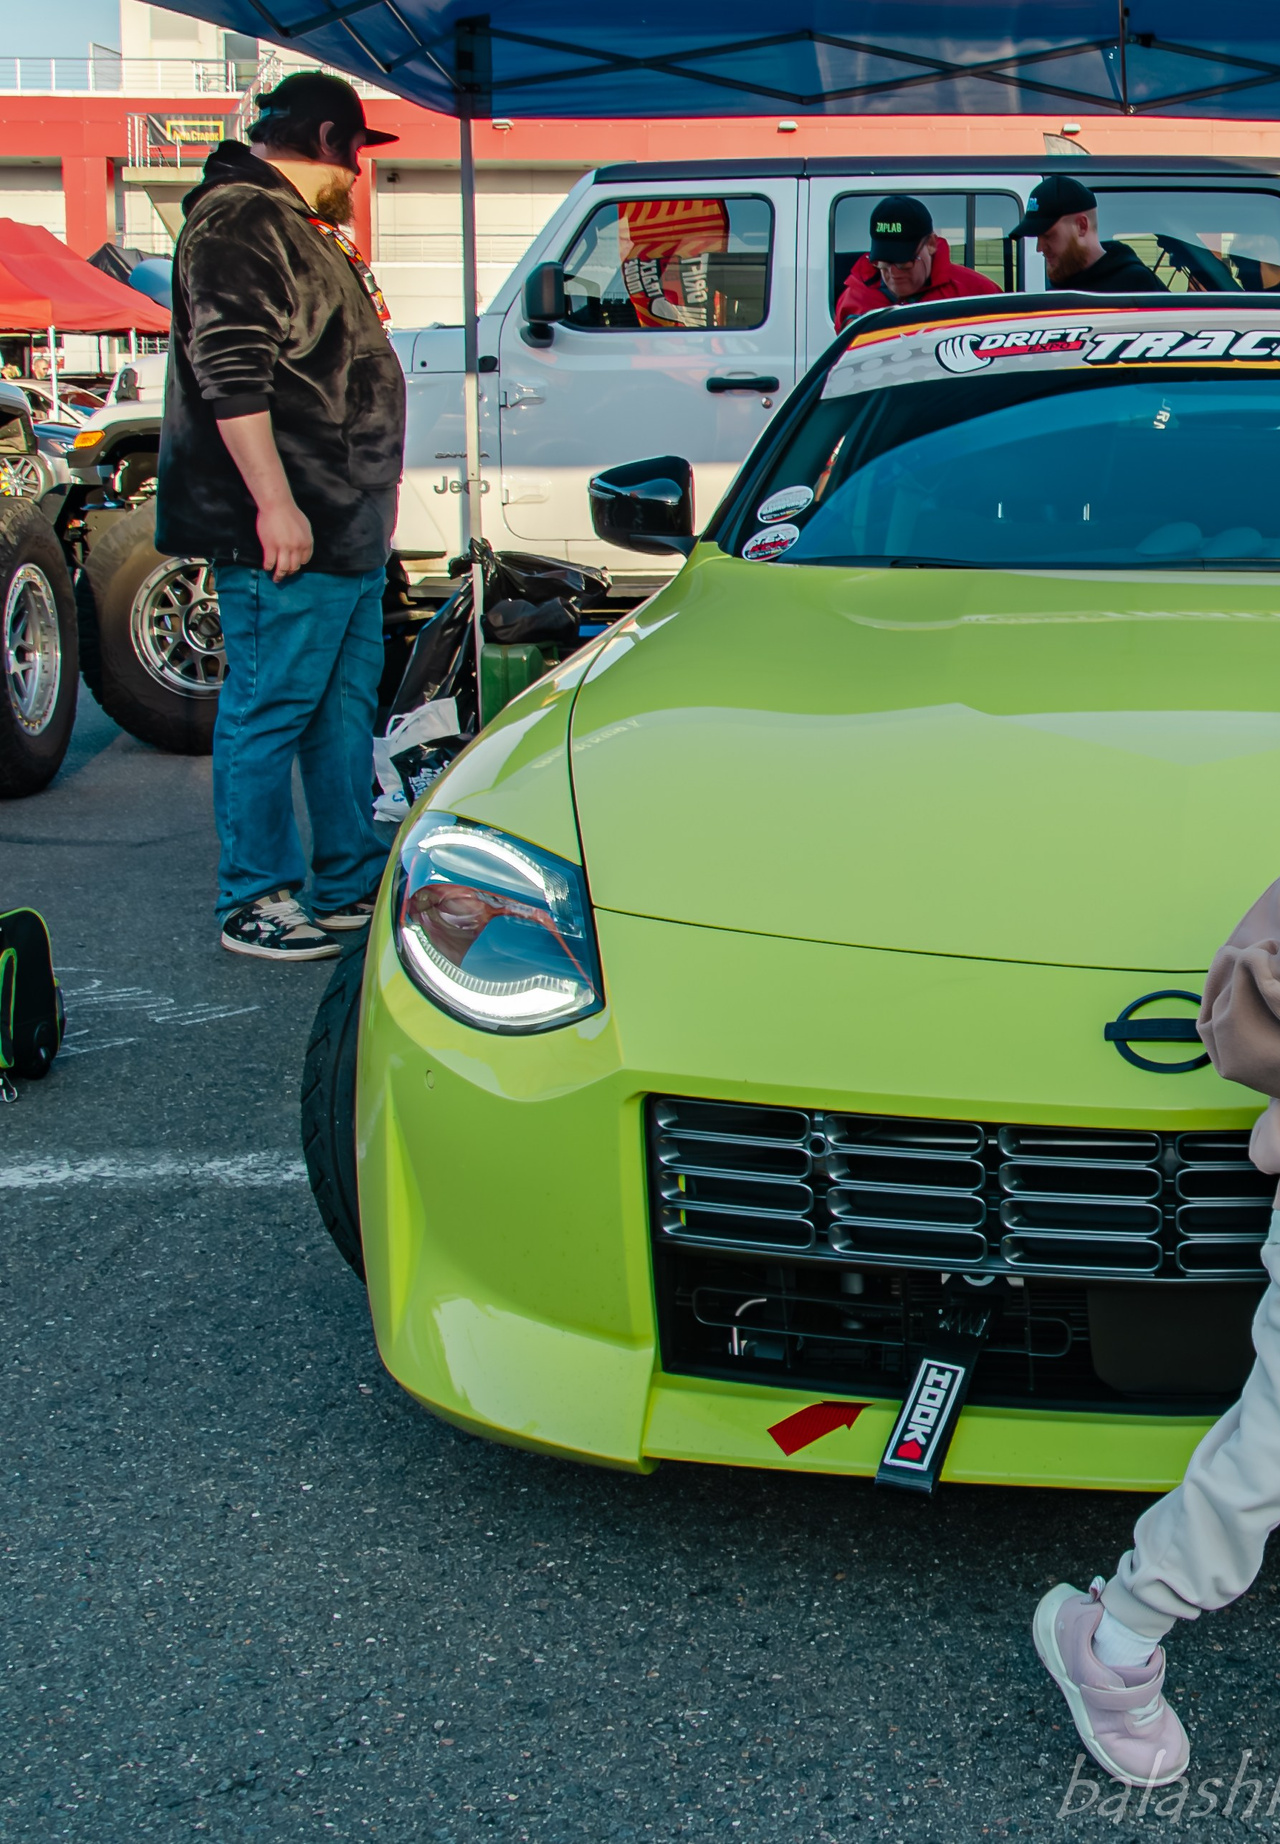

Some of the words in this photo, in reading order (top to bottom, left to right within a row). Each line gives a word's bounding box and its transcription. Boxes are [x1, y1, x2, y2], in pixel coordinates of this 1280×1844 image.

[876, 221, 902, 233] ZAPLAB
[978, 326, 1091, 351] DRIFT
[1027, 341, 1071, 352] EXPO
[902, 1367, 953, 1445] HOOK
